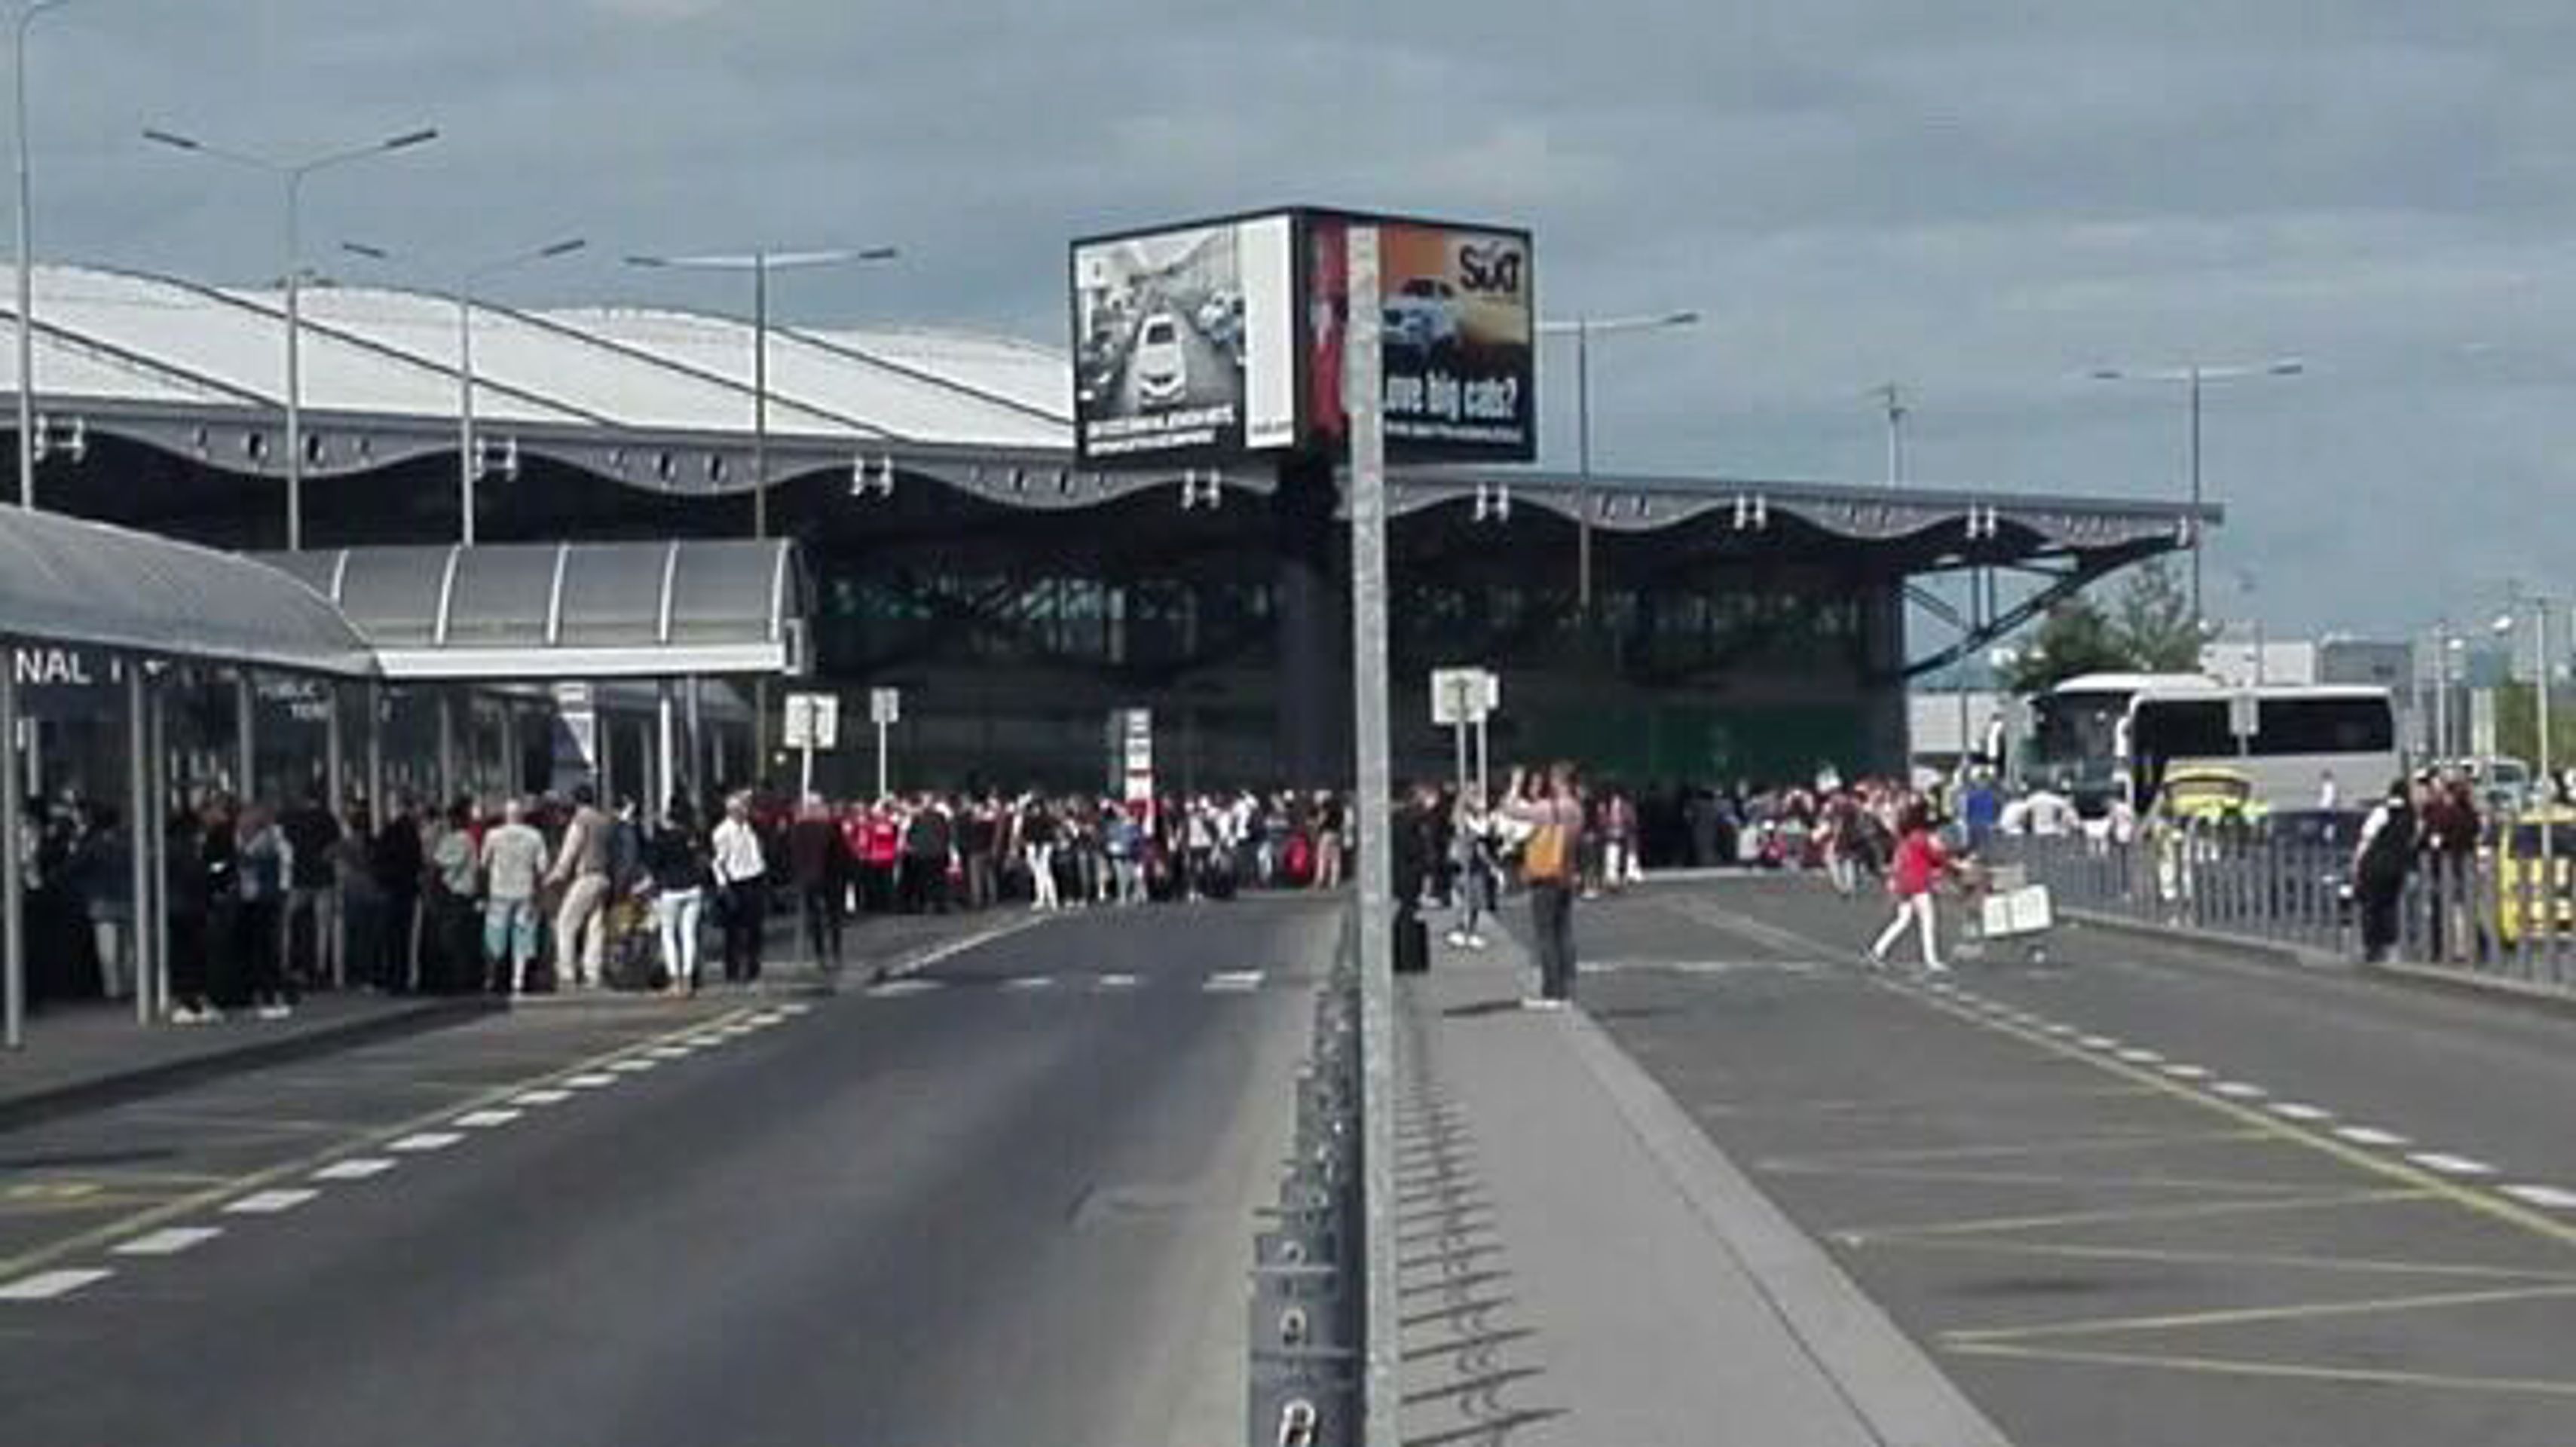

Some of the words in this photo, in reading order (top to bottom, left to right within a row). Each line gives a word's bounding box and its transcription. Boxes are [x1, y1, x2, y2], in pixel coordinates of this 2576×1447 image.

[1381, 375, 1423, 413] ove
[1425, 369, 1459, 423] big
[14, 647, 92, 684] NAL
